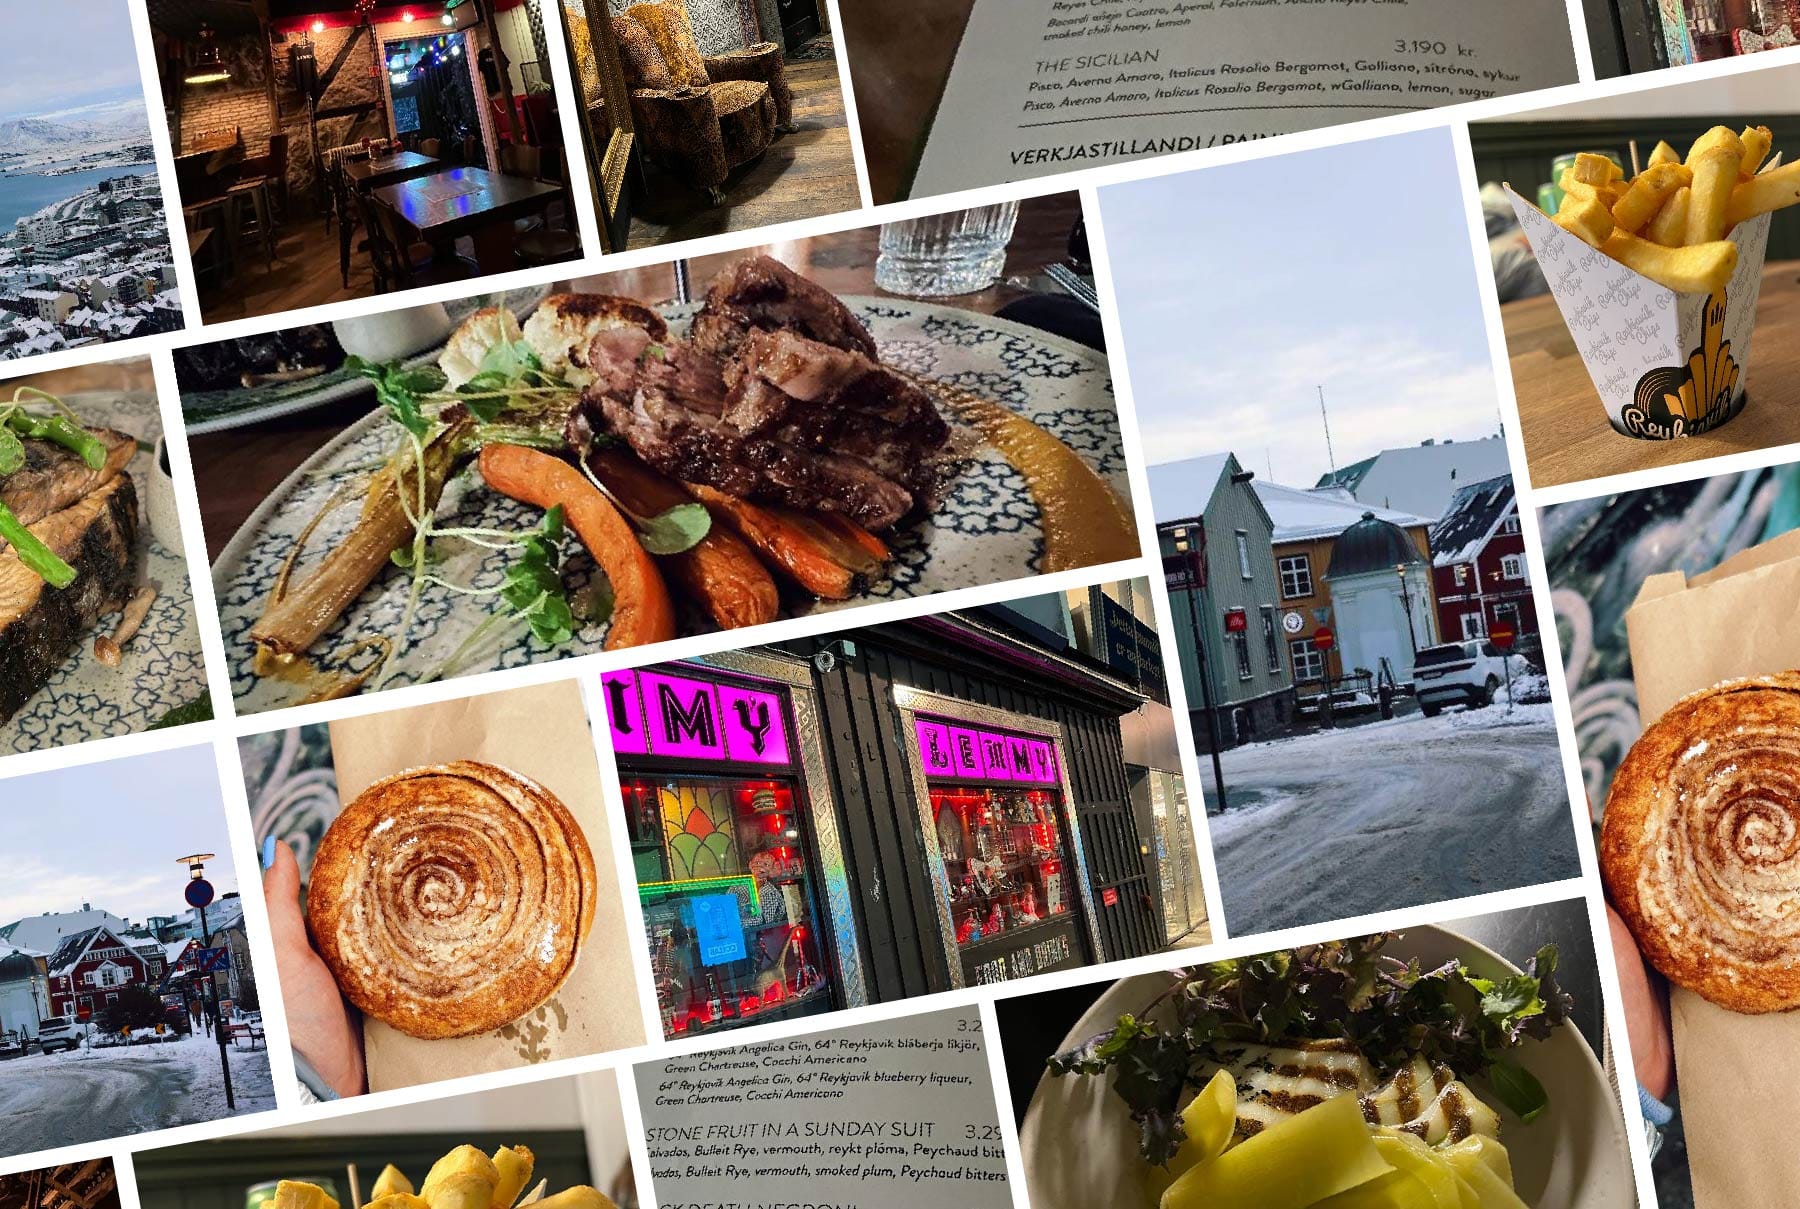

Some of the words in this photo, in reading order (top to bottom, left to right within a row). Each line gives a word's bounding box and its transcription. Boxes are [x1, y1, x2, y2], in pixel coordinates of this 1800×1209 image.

[1126, 7, 1169, 18] Cuatro,
[1173, 3, 1215, 15] Aperol,
[1043, 28, 1086, 41] smoked
[1113, 20, 1150, 33] honey,
[1155, 17, 1191, 28] lemon
[1394, 40, 1446, 55] 3.190
[1457, 44, 1477, 58] kr.
[1036, 57, 1072, 74] THE
[1074, 49, 1160, 69] SICILIAN
[1028, 81, 1063, 92] Pisco,
[1066, 76, 1112, 89] Averna
[1115, 73, 1164, 84] Amaro,
[1169, 68, 1216, 79] Italicus
[1275, 60, 1349, 75] Bergamot,
[1354, 59, 1420, 74] Galliano,
[1023, 100, 1055, 111] Pisco,
[1058, 96, 1102, 107] Averna
[1105, 92, 1150, 103] Amaro,
[1154, 86, 1199, 98] Italicus
[1256, 80, 1325, 94] Bergamot,
[1407, 80, 1453, 96] lemon,
[1458, 86, 1496, 99] sugar
[1010, 135, 1201, 165] VERKJASTILLANDI
[924, 727, 1048, 780] LEMMY
[740, 1042, 785, 1057] Angelica
[788, 1041, 811, 1052] Gin,
[814, 1039, 836, 1050] 64°
[839, 1039, 894, 1053] Reykjavik
[665, 1063, 696, 1074] Green
[699, 1061, 759, 1073] Chartreuse,
[762, 1055, 801, 1066] Cocchi
[804, 1054, 867, 1065] Americano
[726, 1075, 769, 1090] Angelica
[772, 1073, 793, 1085] Gin,
[796, 1072, 817, 1083] 64°
[819, 1071, 871, 1085] Reykjavik
[874, 1071, 927, 1087] blueberry
[929, 1072, 972, 1086] liqueur,
[655, 1095, 684, 1106] Green
[687, 1093, 742, 1105] Chartreuse,
[746, 1089, 782, 1101] Cocchi
[784, 1089, 844, 1101] Americano
[646, 1126, 703, 1142] STONE
[706, 1123, 758, 1139] FRUIT
[761, 1122, 782, 1138] IN
[785, 1122, 799, 1137] A
[805, 1121, 887, 1137] SUNDAY
[890, 1121, 936, 1137] SUIT
[694, 1144, 730, 1157] Bulleit
[733, 1143, 759, 1159] Rye,
[763, 1142, 825, 1156] vermouth,
[828, 1143, 862, 1158] reykt
[865, 1142, 909, 1159] plóma,
[913, 1142, 978, 1160] Peychaud
[686, 1165, 722, 1178] Bulleit
[725, 1164, 751, 1180] Rye,
[755, 1164, 811, 1178] vermouth,
[815, 1165, 860, 1177] smoked
[862, 1165, 896, 1180] plum,
[900, 1164, 963, 1182] Peychaud
[965, 1167, 1007, 1182] bitters
